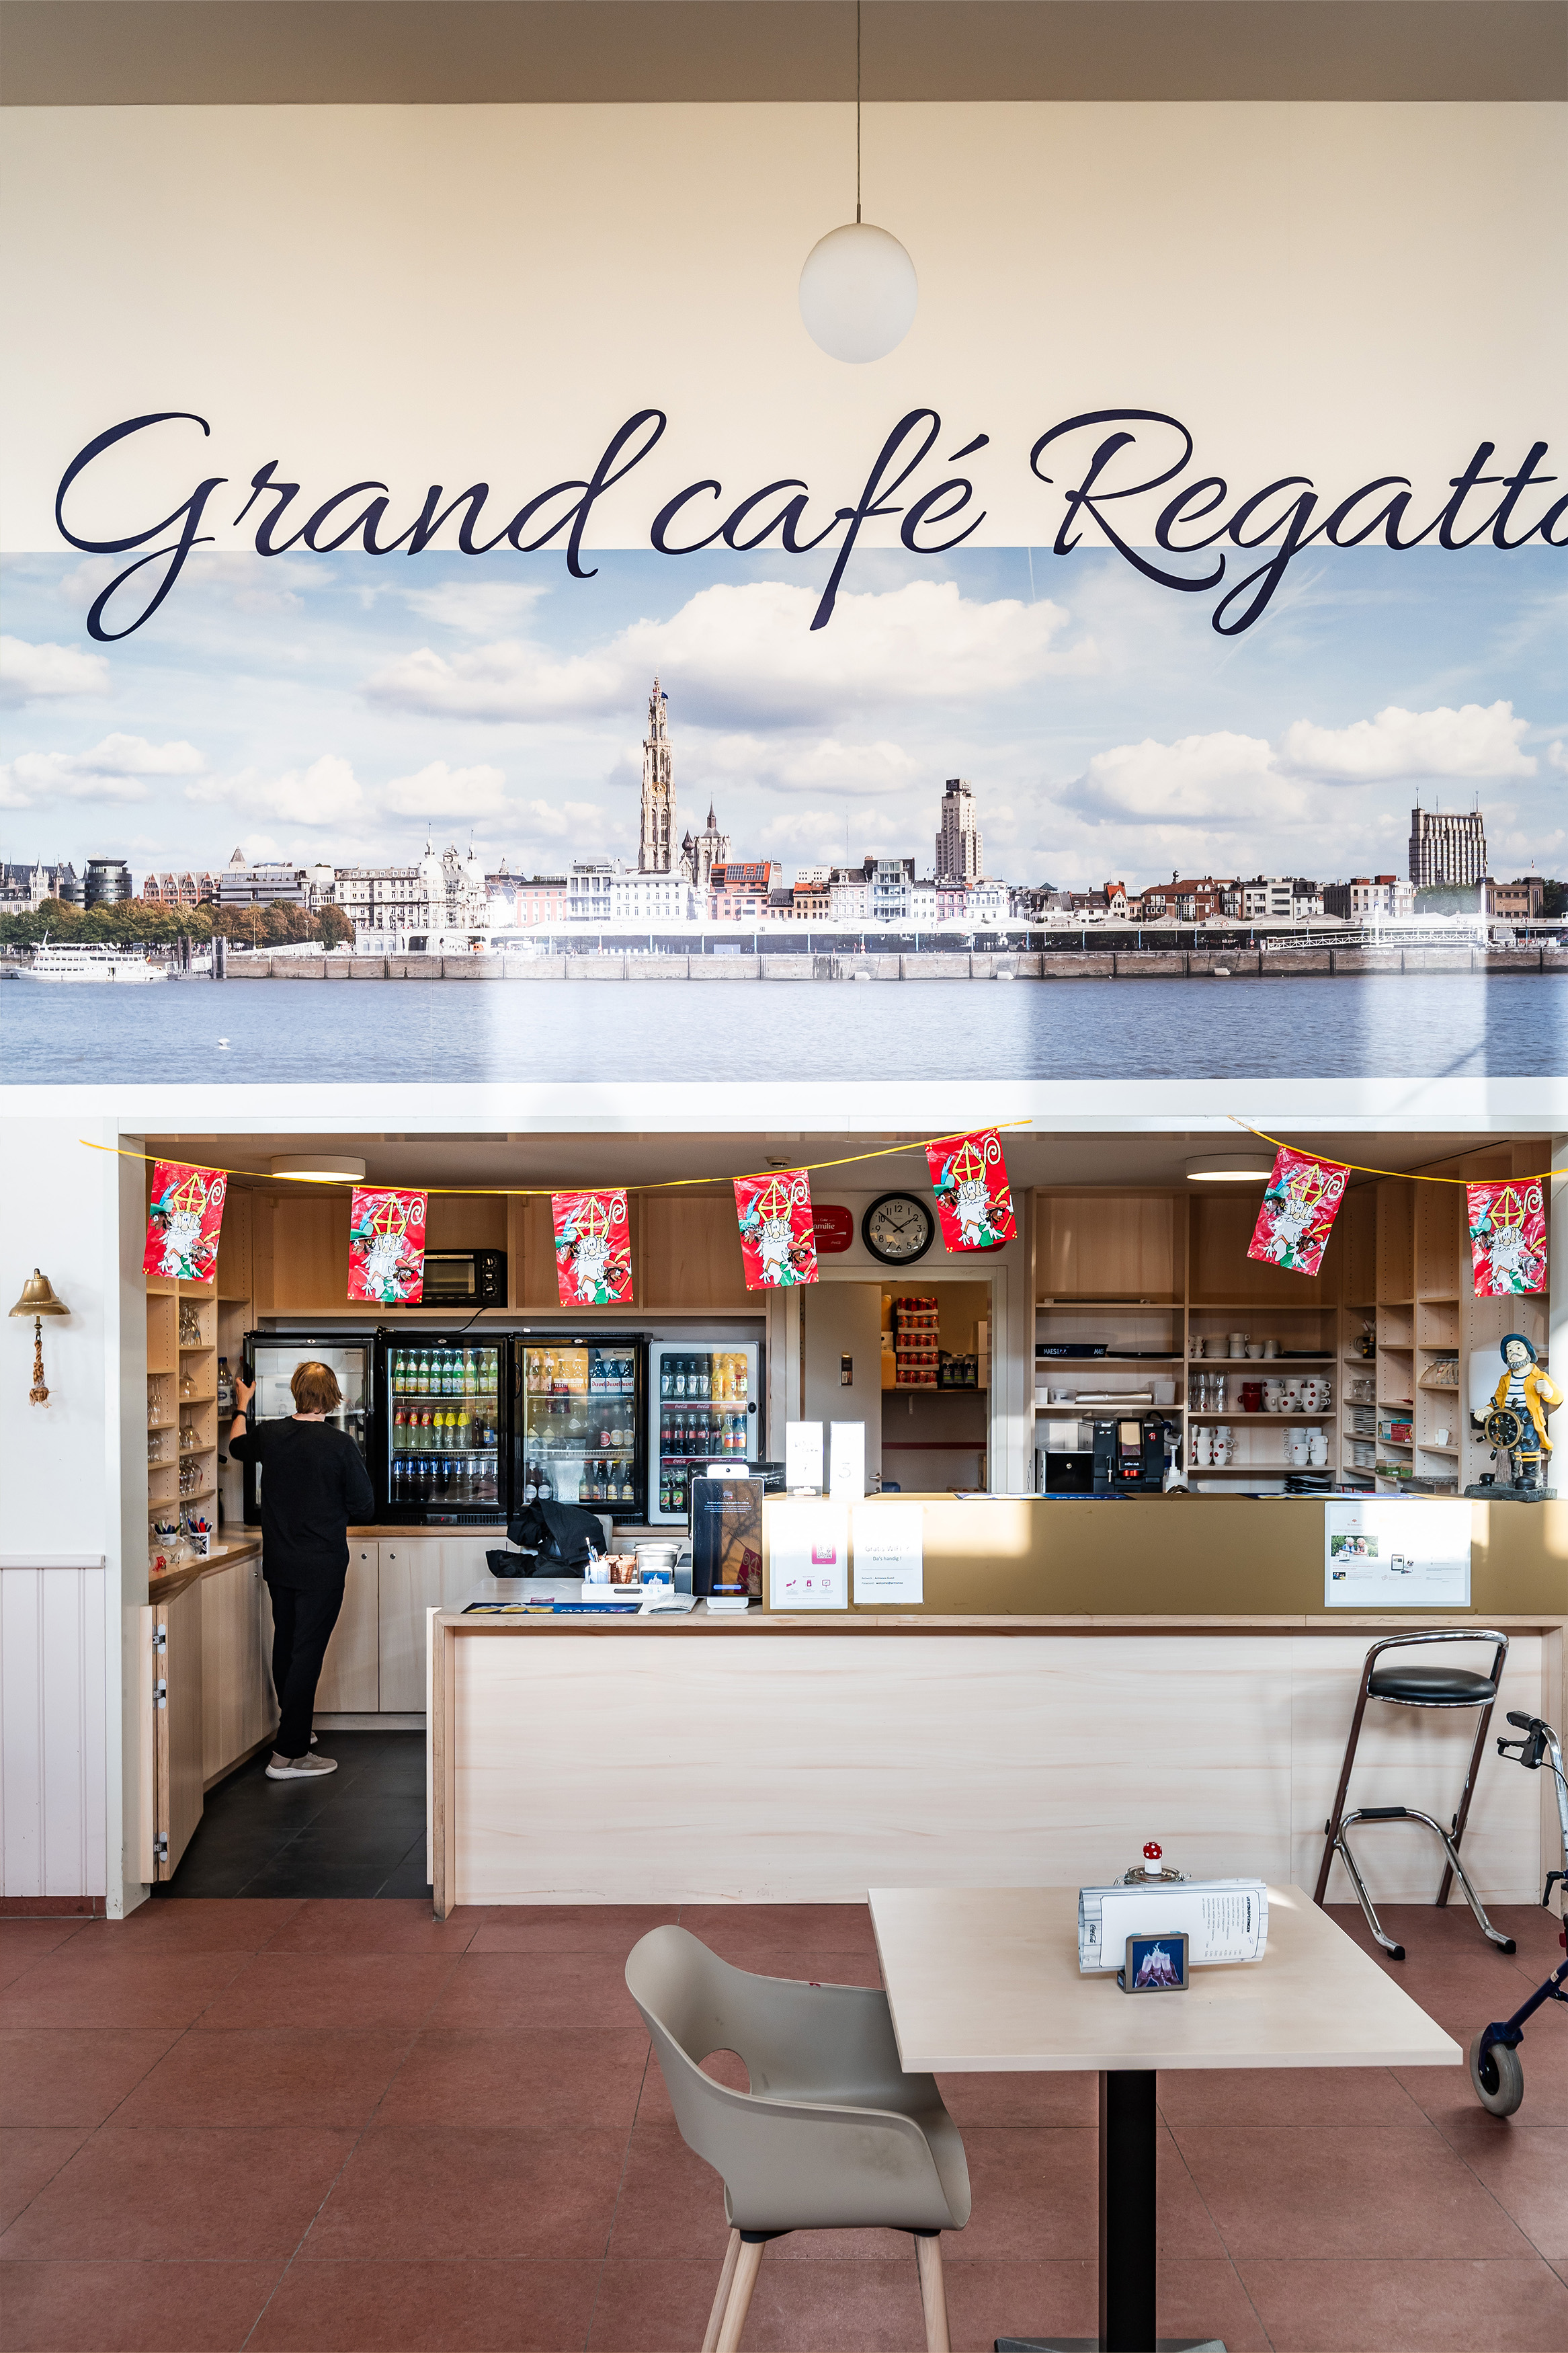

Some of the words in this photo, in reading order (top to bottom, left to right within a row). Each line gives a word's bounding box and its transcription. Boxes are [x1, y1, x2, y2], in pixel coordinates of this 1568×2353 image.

[56, 409, 666, 641] Grand
[651, 409, 989, 631] café
[895, 1205, 903, 1213] 12
